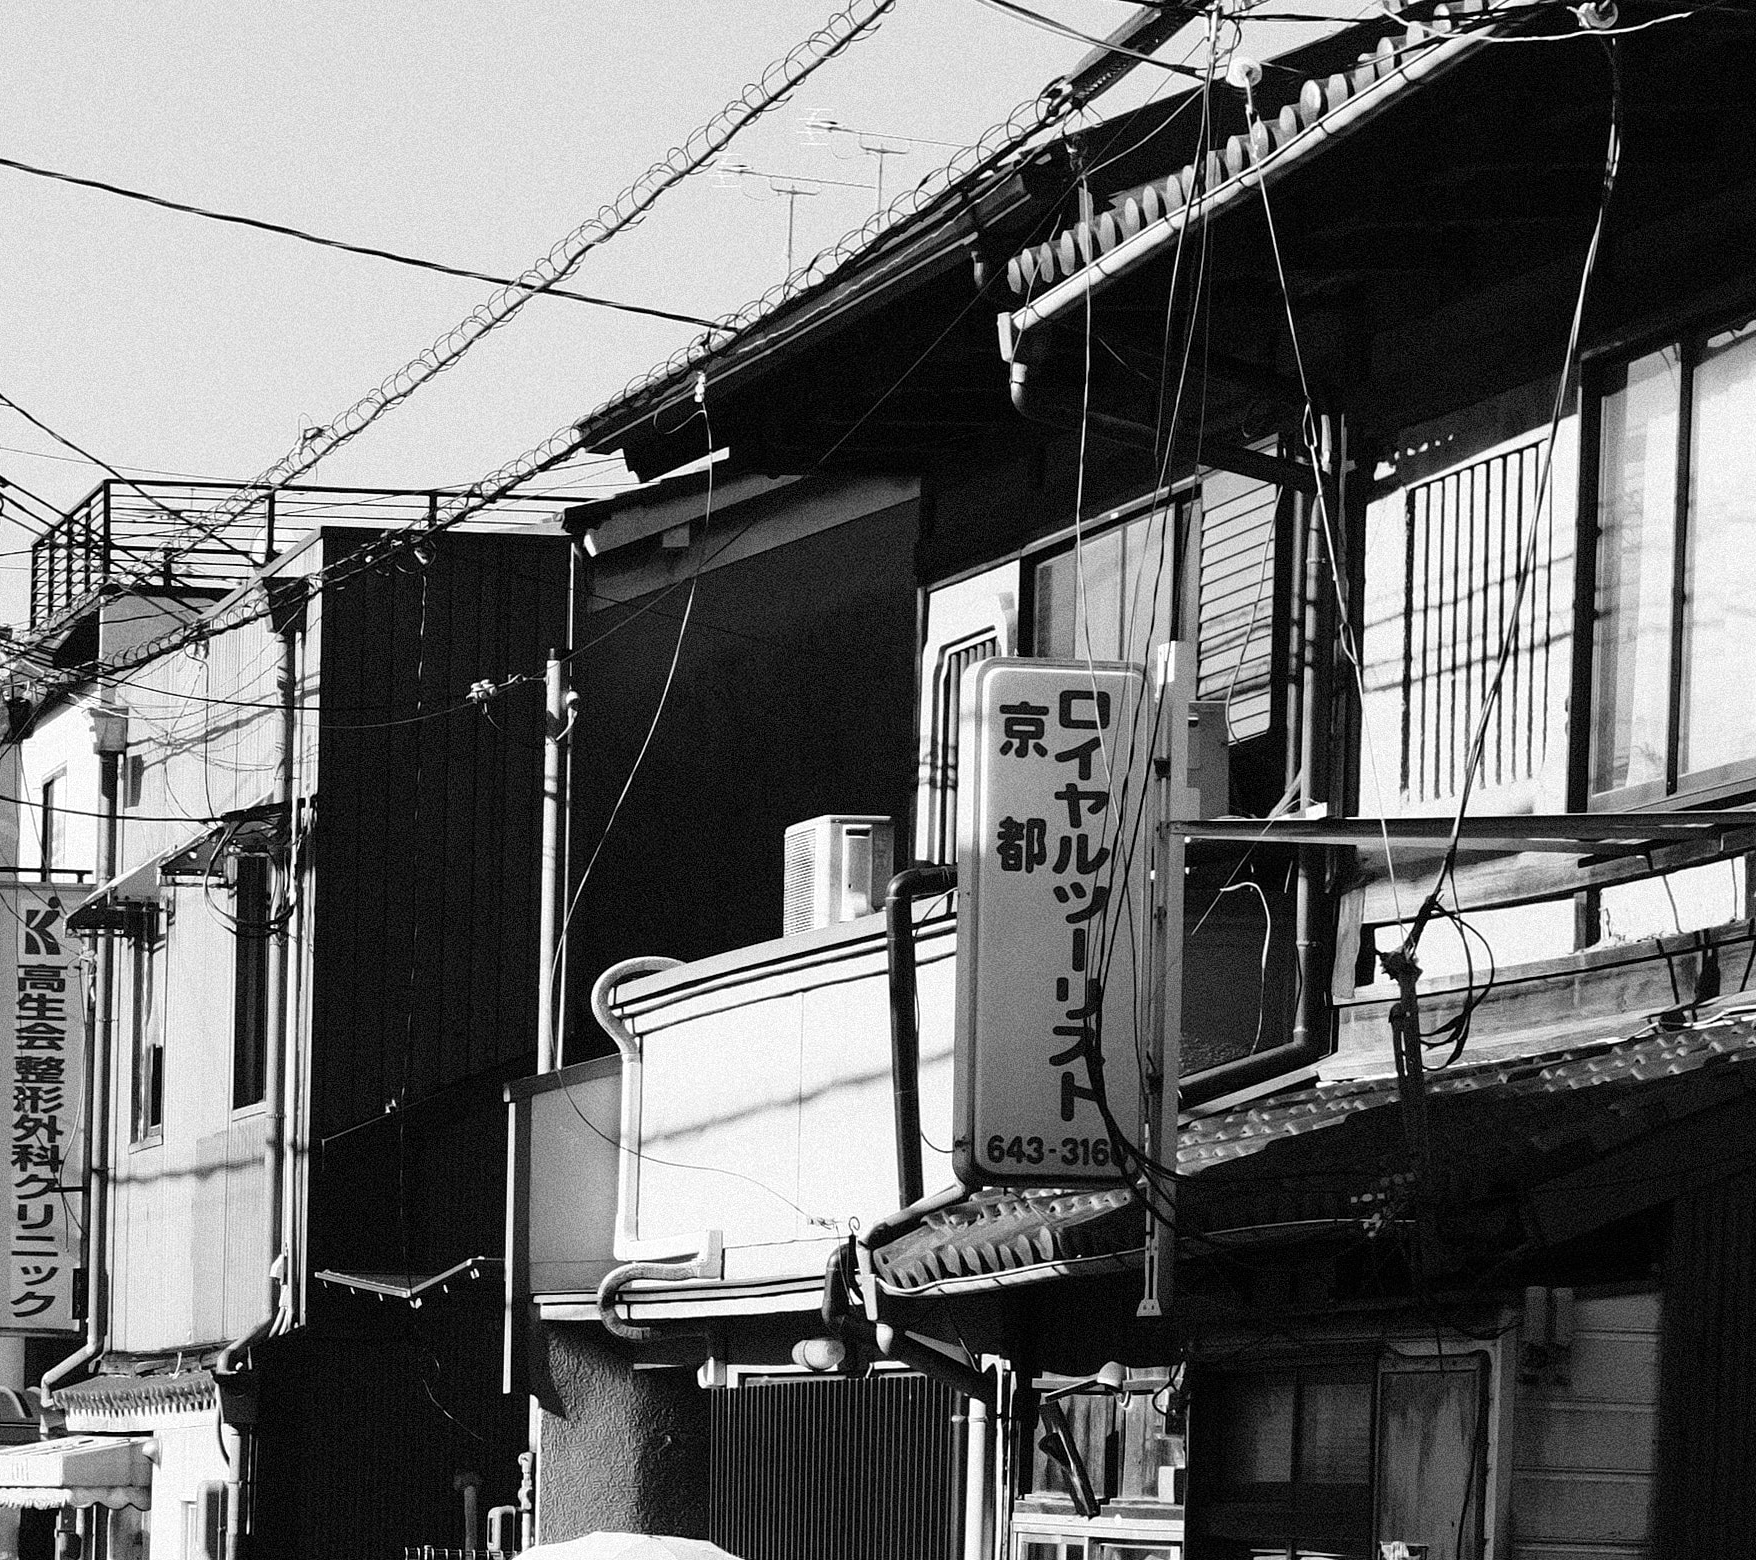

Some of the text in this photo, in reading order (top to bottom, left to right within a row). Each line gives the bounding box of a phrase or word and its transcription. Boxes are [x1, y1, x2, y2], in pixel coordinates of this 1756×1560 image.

[996, 701, 1050, 873] 京都
[1049, 690, 1111, 1122] ロイヤルツーリスト
